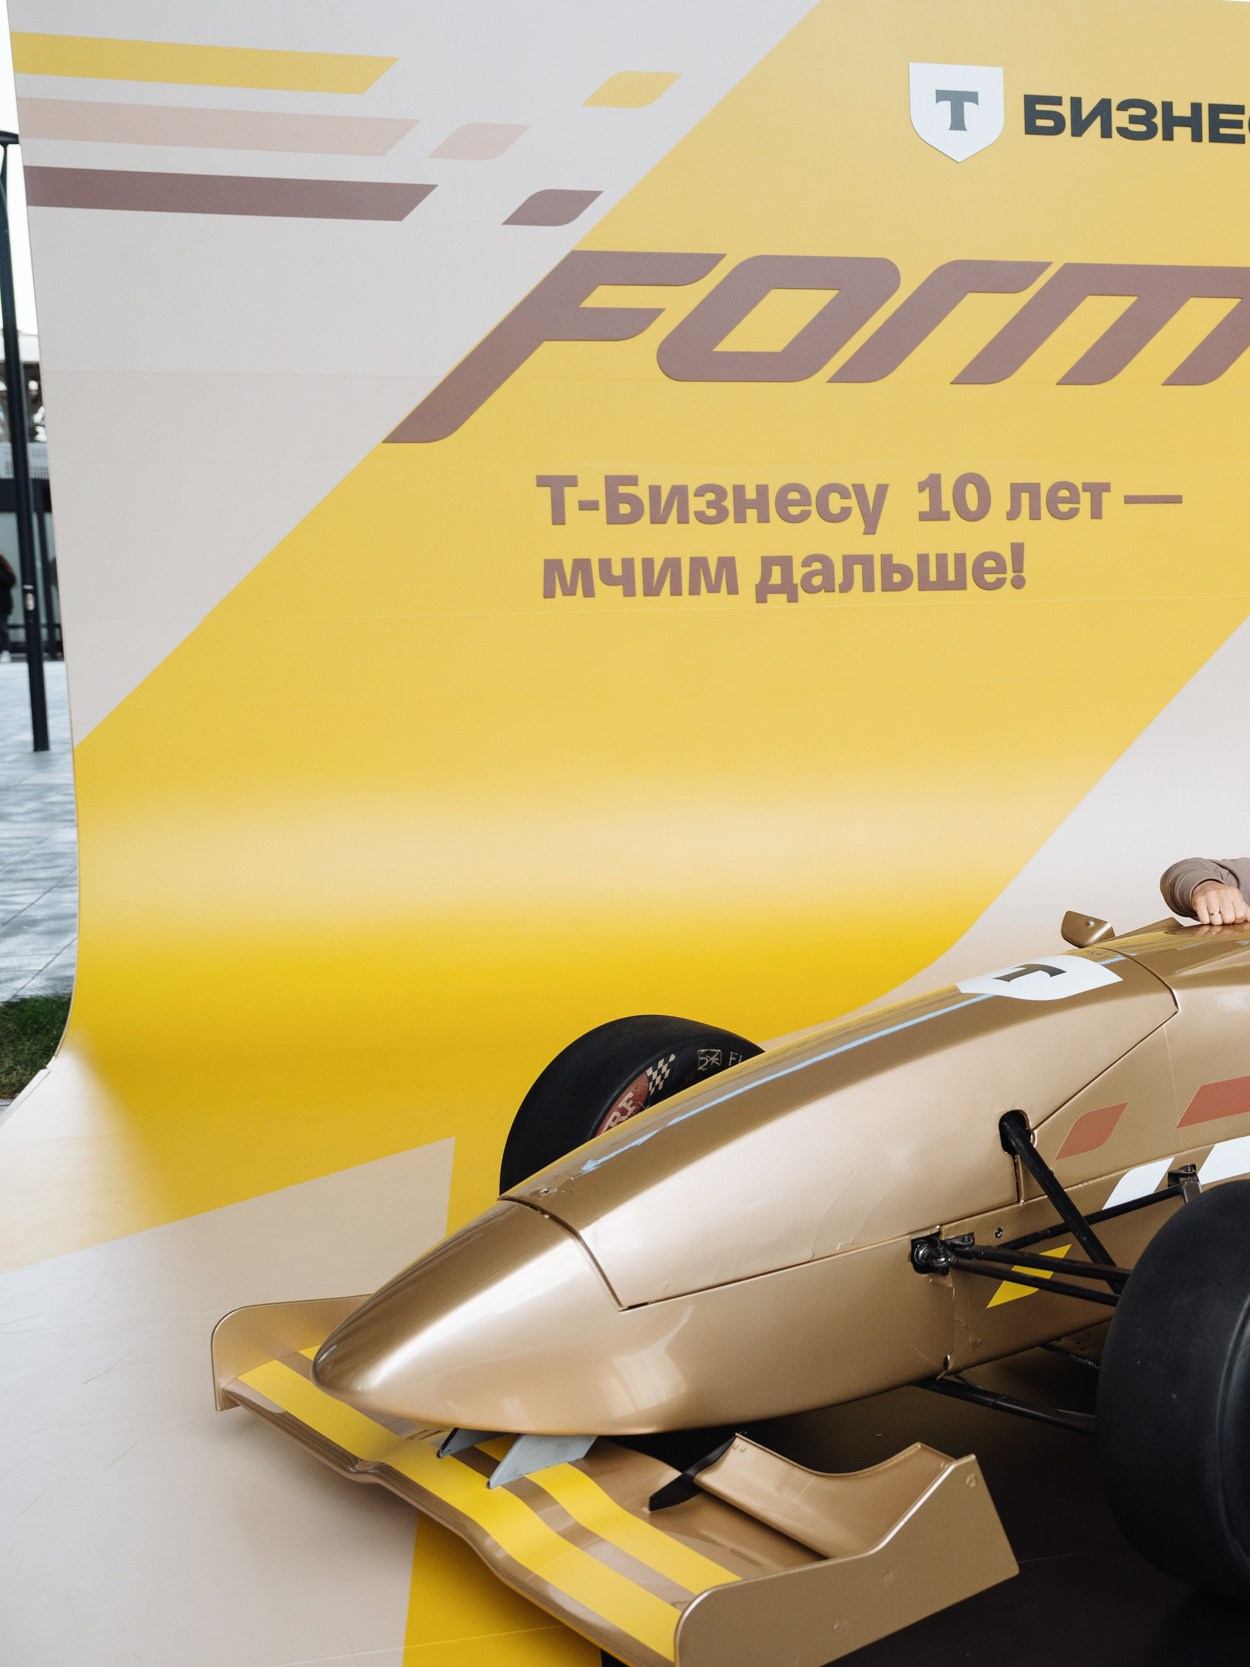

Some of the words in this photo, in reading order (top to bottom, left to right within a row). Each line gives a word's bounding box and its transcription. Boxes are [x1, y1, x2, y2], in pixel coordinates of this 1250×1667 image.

[536, 475, 889, 535] Т-Бизнесу
[918, 472, 991, 522] 10
[1006, 481, 1111, 521] лет
[543, 556, 739, 599] мчим
[755, 542, 1026, 604] дальше!
